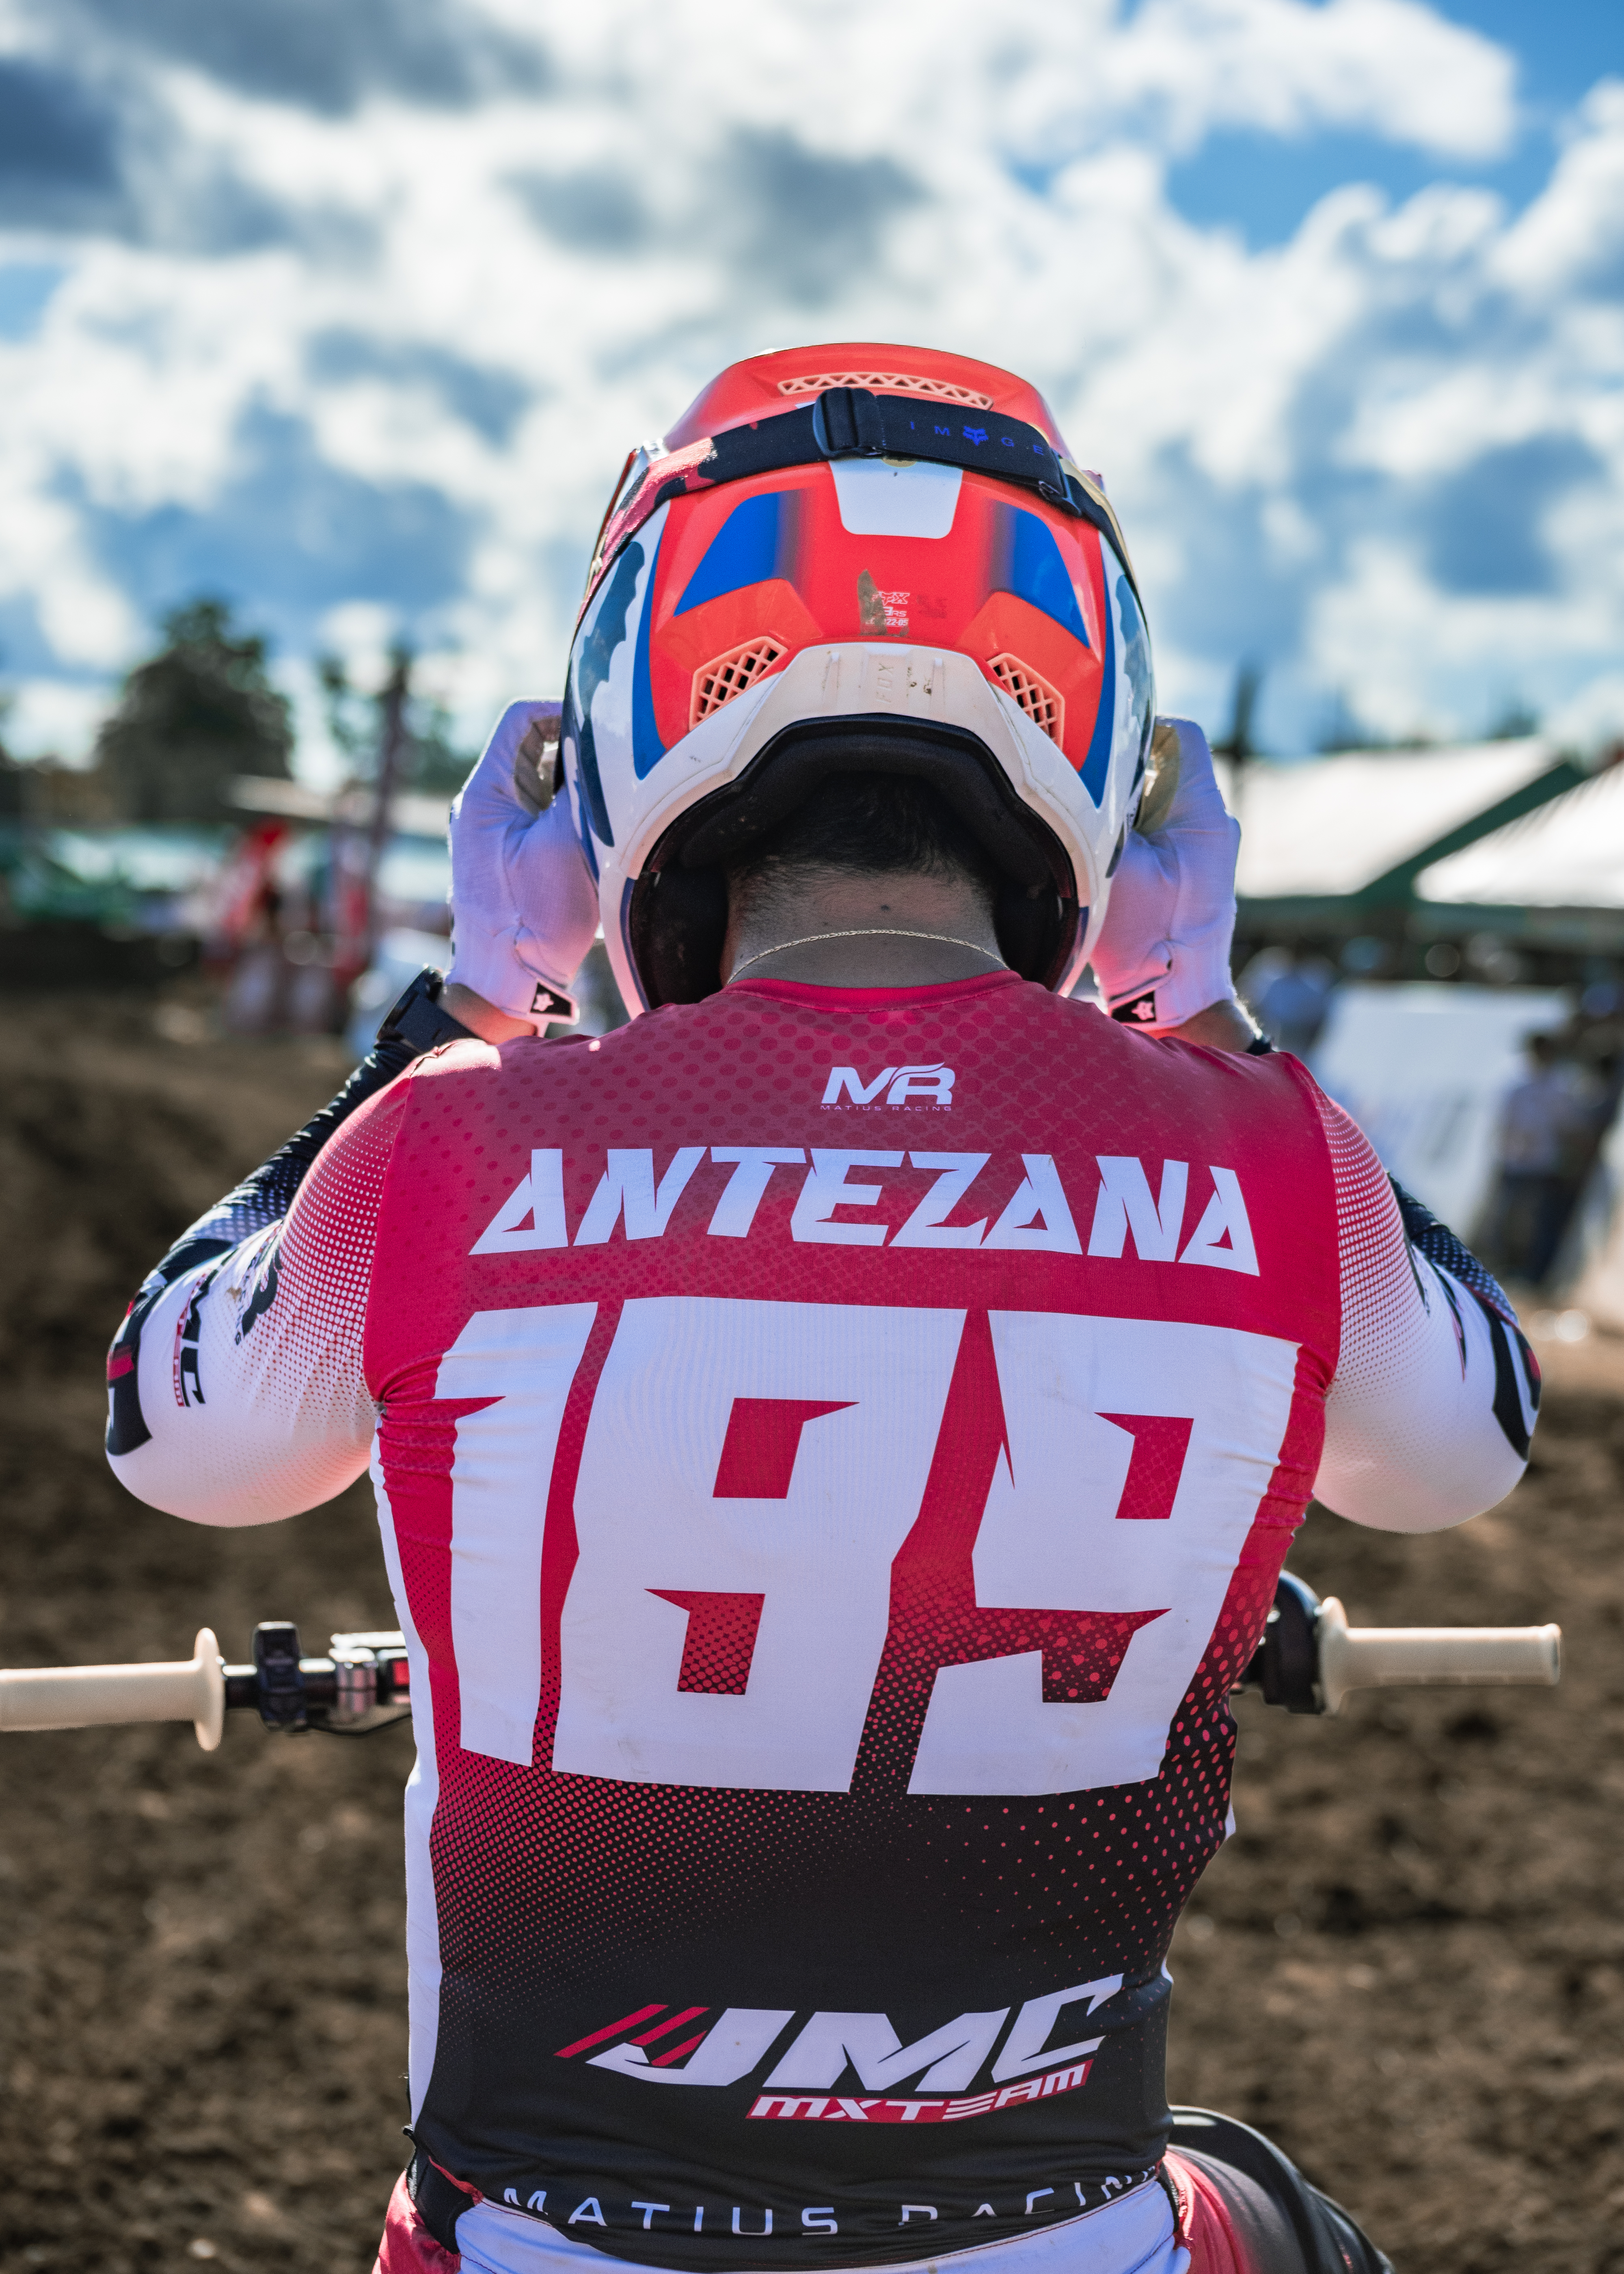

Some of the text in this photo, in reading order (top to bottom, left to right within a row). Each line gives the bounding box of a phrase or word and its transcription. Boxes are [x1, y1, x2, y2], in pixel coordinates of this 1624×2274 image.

[821, 1062, 955, 1105] MR
[469, 1146, 1260, 1277] ANTEZANA
[433, 1296, 1302, 1796] 189
[585, 1973, 1124, 2092] JMC
[503, 2166, 1156, 2236] MATIUS RACIN
